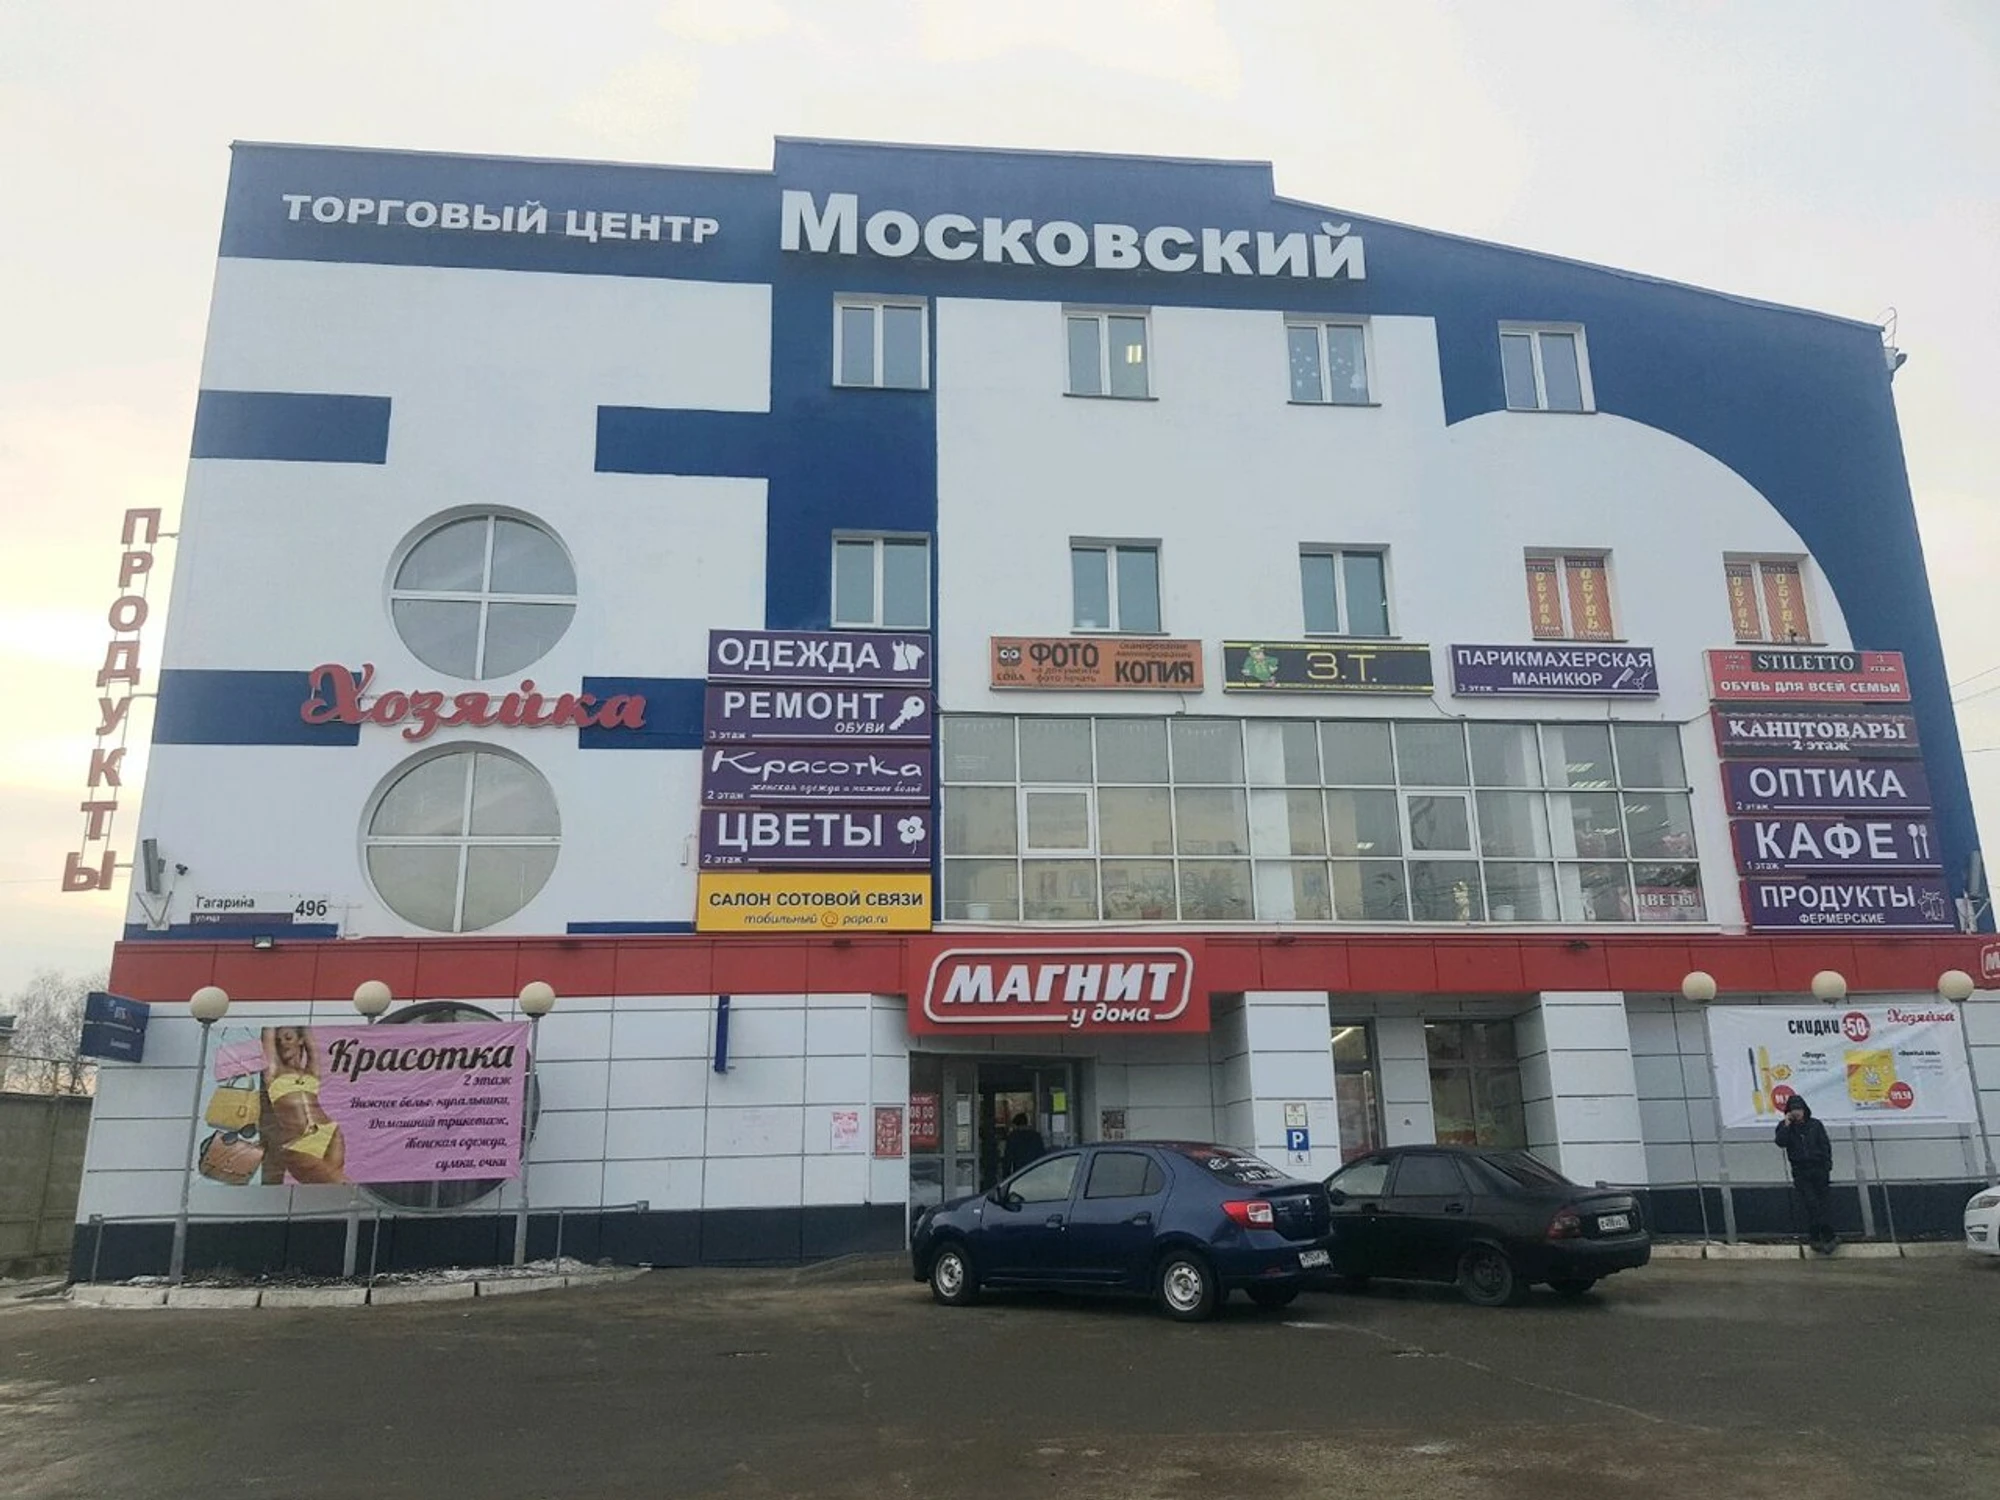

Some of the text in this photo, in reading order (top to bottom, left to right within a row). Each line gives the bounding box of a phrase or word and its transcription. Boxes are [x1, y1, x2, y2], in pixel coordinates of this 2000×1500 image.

[282, 194, 719, 243] ТОРГОВЫЙ ЦЕНТР
[781, 190, 1366, 280] Московский
[717, 638, 881, 673] ОДЕЖДА
[1029, 643, 1099, 668] ФОТО
[1457, 650, 1653, 668] ПАРИКМАХЕРСКАЯ
[1757, 653, 1854, 671] STILETTO
[1115, 660, 1194, 683] КОПИЯ
[1512, 671, 1602, 686] МАНИКЮР
[1720, 679, 1900, 693] ОБУВЬ ДЛЯ ВСЕЙ СЕМЬИ
[61, 507, 162, 892] ПРОДУКТЫ
[301, 663, 647, 743] Хозяйка
[724, 691, 884, 719] РЕМОНТ
[709, 731, 716, 739] 3
[835, 723, 885, 734] ОБУВИ
[1729, 720, 1907, 739] КАНЦТОВАРЫ
[1793, 740, 1850, 751] 2 этаж
[711, 750, 923, 781] Красотка
[1750, 768, 1908, 798] ОПТИКА
[708, 791, 714, 799] 2
[1736, 802, 1742, 810] 2
[718, 813, 882, 852] ЦВЕТЫ
[1754, 821, 1898, 860] КАФЕ
[705, 855, 743, 864] 2 этаж
[196, 895, 255, 910] Гагарина
[709, 890, 923, 907] САЛОН СОТОВОЙ СВЯЗИ
[1760, 885, 1916, 911] ПРОДУКТЫ
[1799, 912, 1886, 924] ФЕРМЕРСКИЕ
[942, 963, 1177, 1003] МАГНИТ
[1070, 1003, 1150, 1028] у дома
[1887, 1008, 1955, 1026] Хозяйка
[1788, 1019, 1840, 1036] СКИДКИ
[329, 1038, 515, 1082] Красотка
[463, 1074, 512, 1085] 2 этаж
[368, 1116, 509, 1131] Домашний трикотаж,
[405, 1136, 456, 1149] Женская
[1292, 1131, 1305, 1149] P
[479, 1158, 507, 1167] очки
